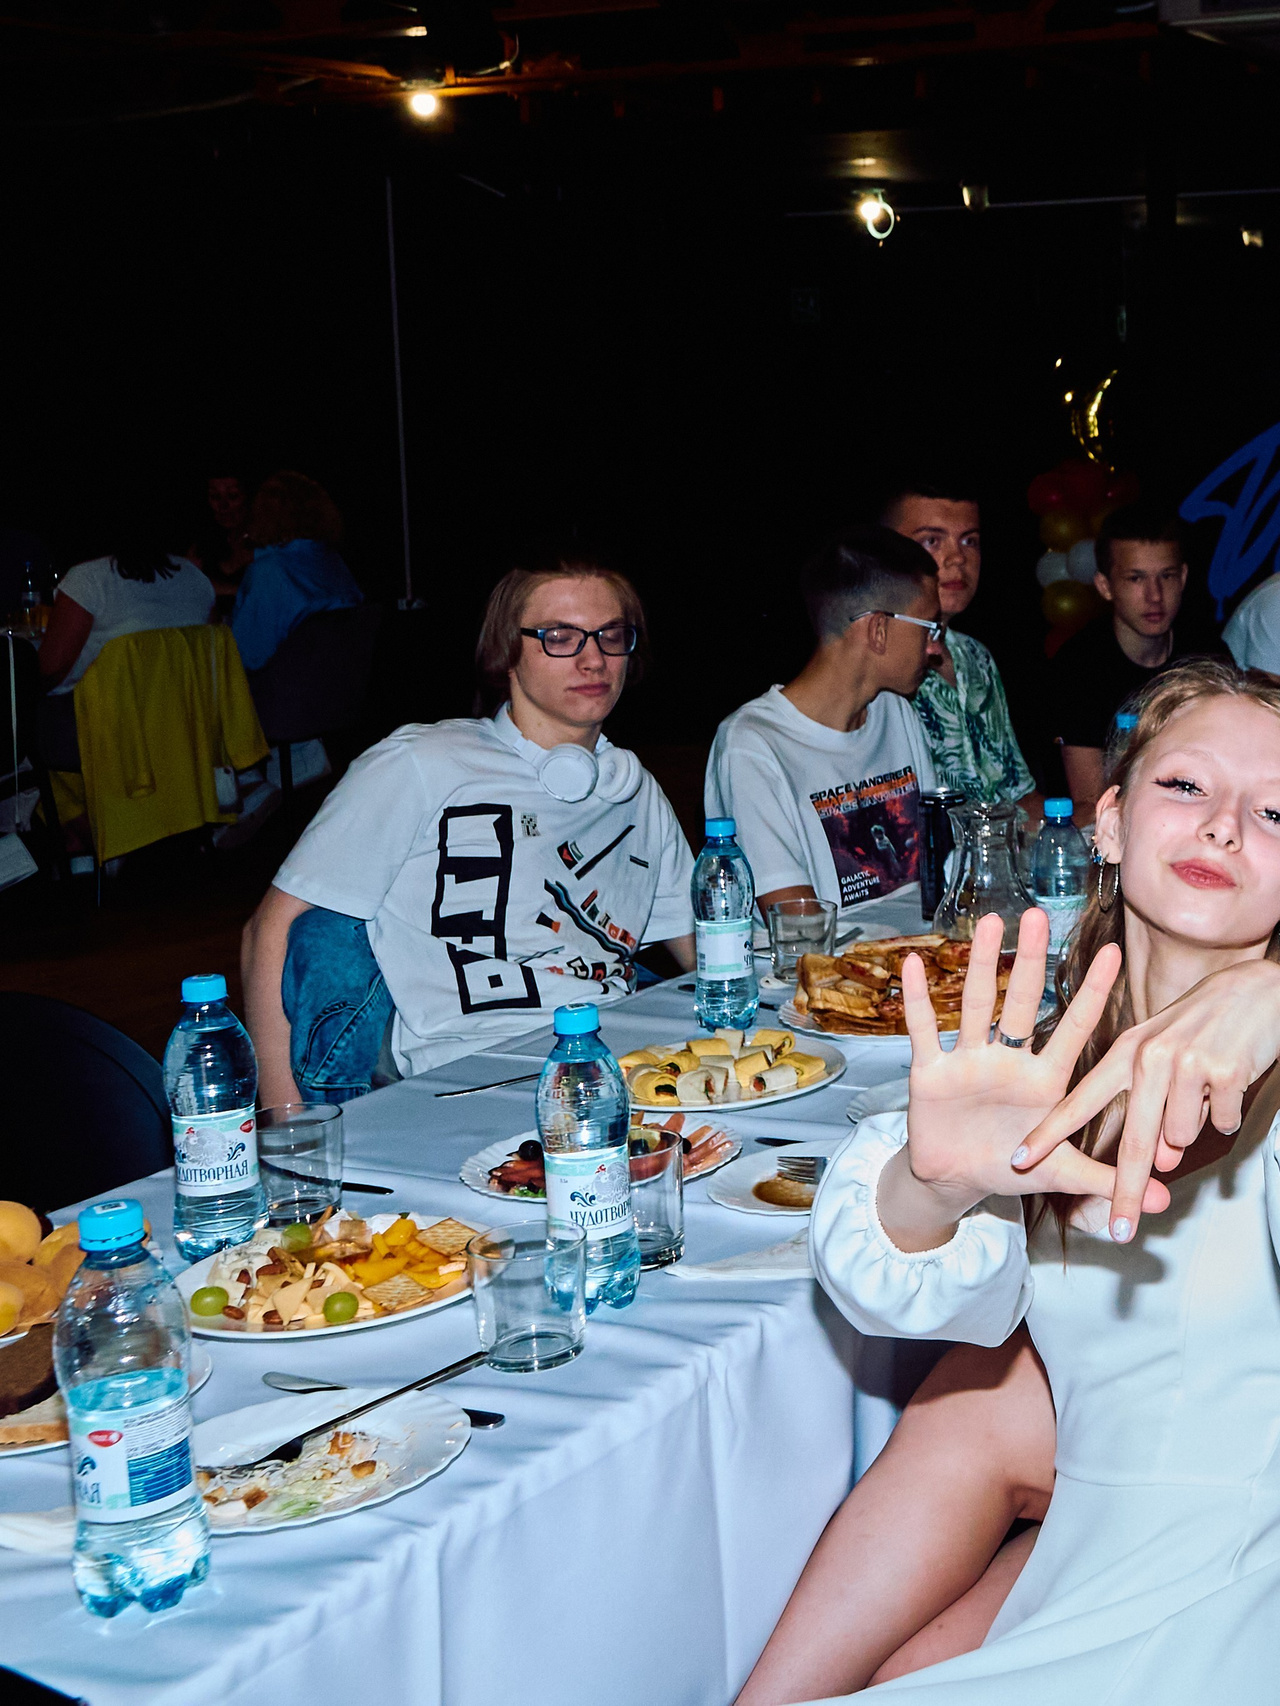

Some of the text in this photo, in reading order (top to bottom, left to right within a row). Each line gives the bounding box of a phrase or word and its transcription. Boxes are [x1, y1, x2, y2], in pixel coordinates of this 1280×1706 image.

[810, 783, 852, 802] SPACE
[840, 869, 871, 885] GALACTIC
[842, 875, 880, 893] ADVENTURE
[843, 888, 869, 902] AWAITS
[178, 1159, 249, 1183] ДОТВОРНАЯ
[570, 1200, 631, 1227] ЧУДОТВОР
